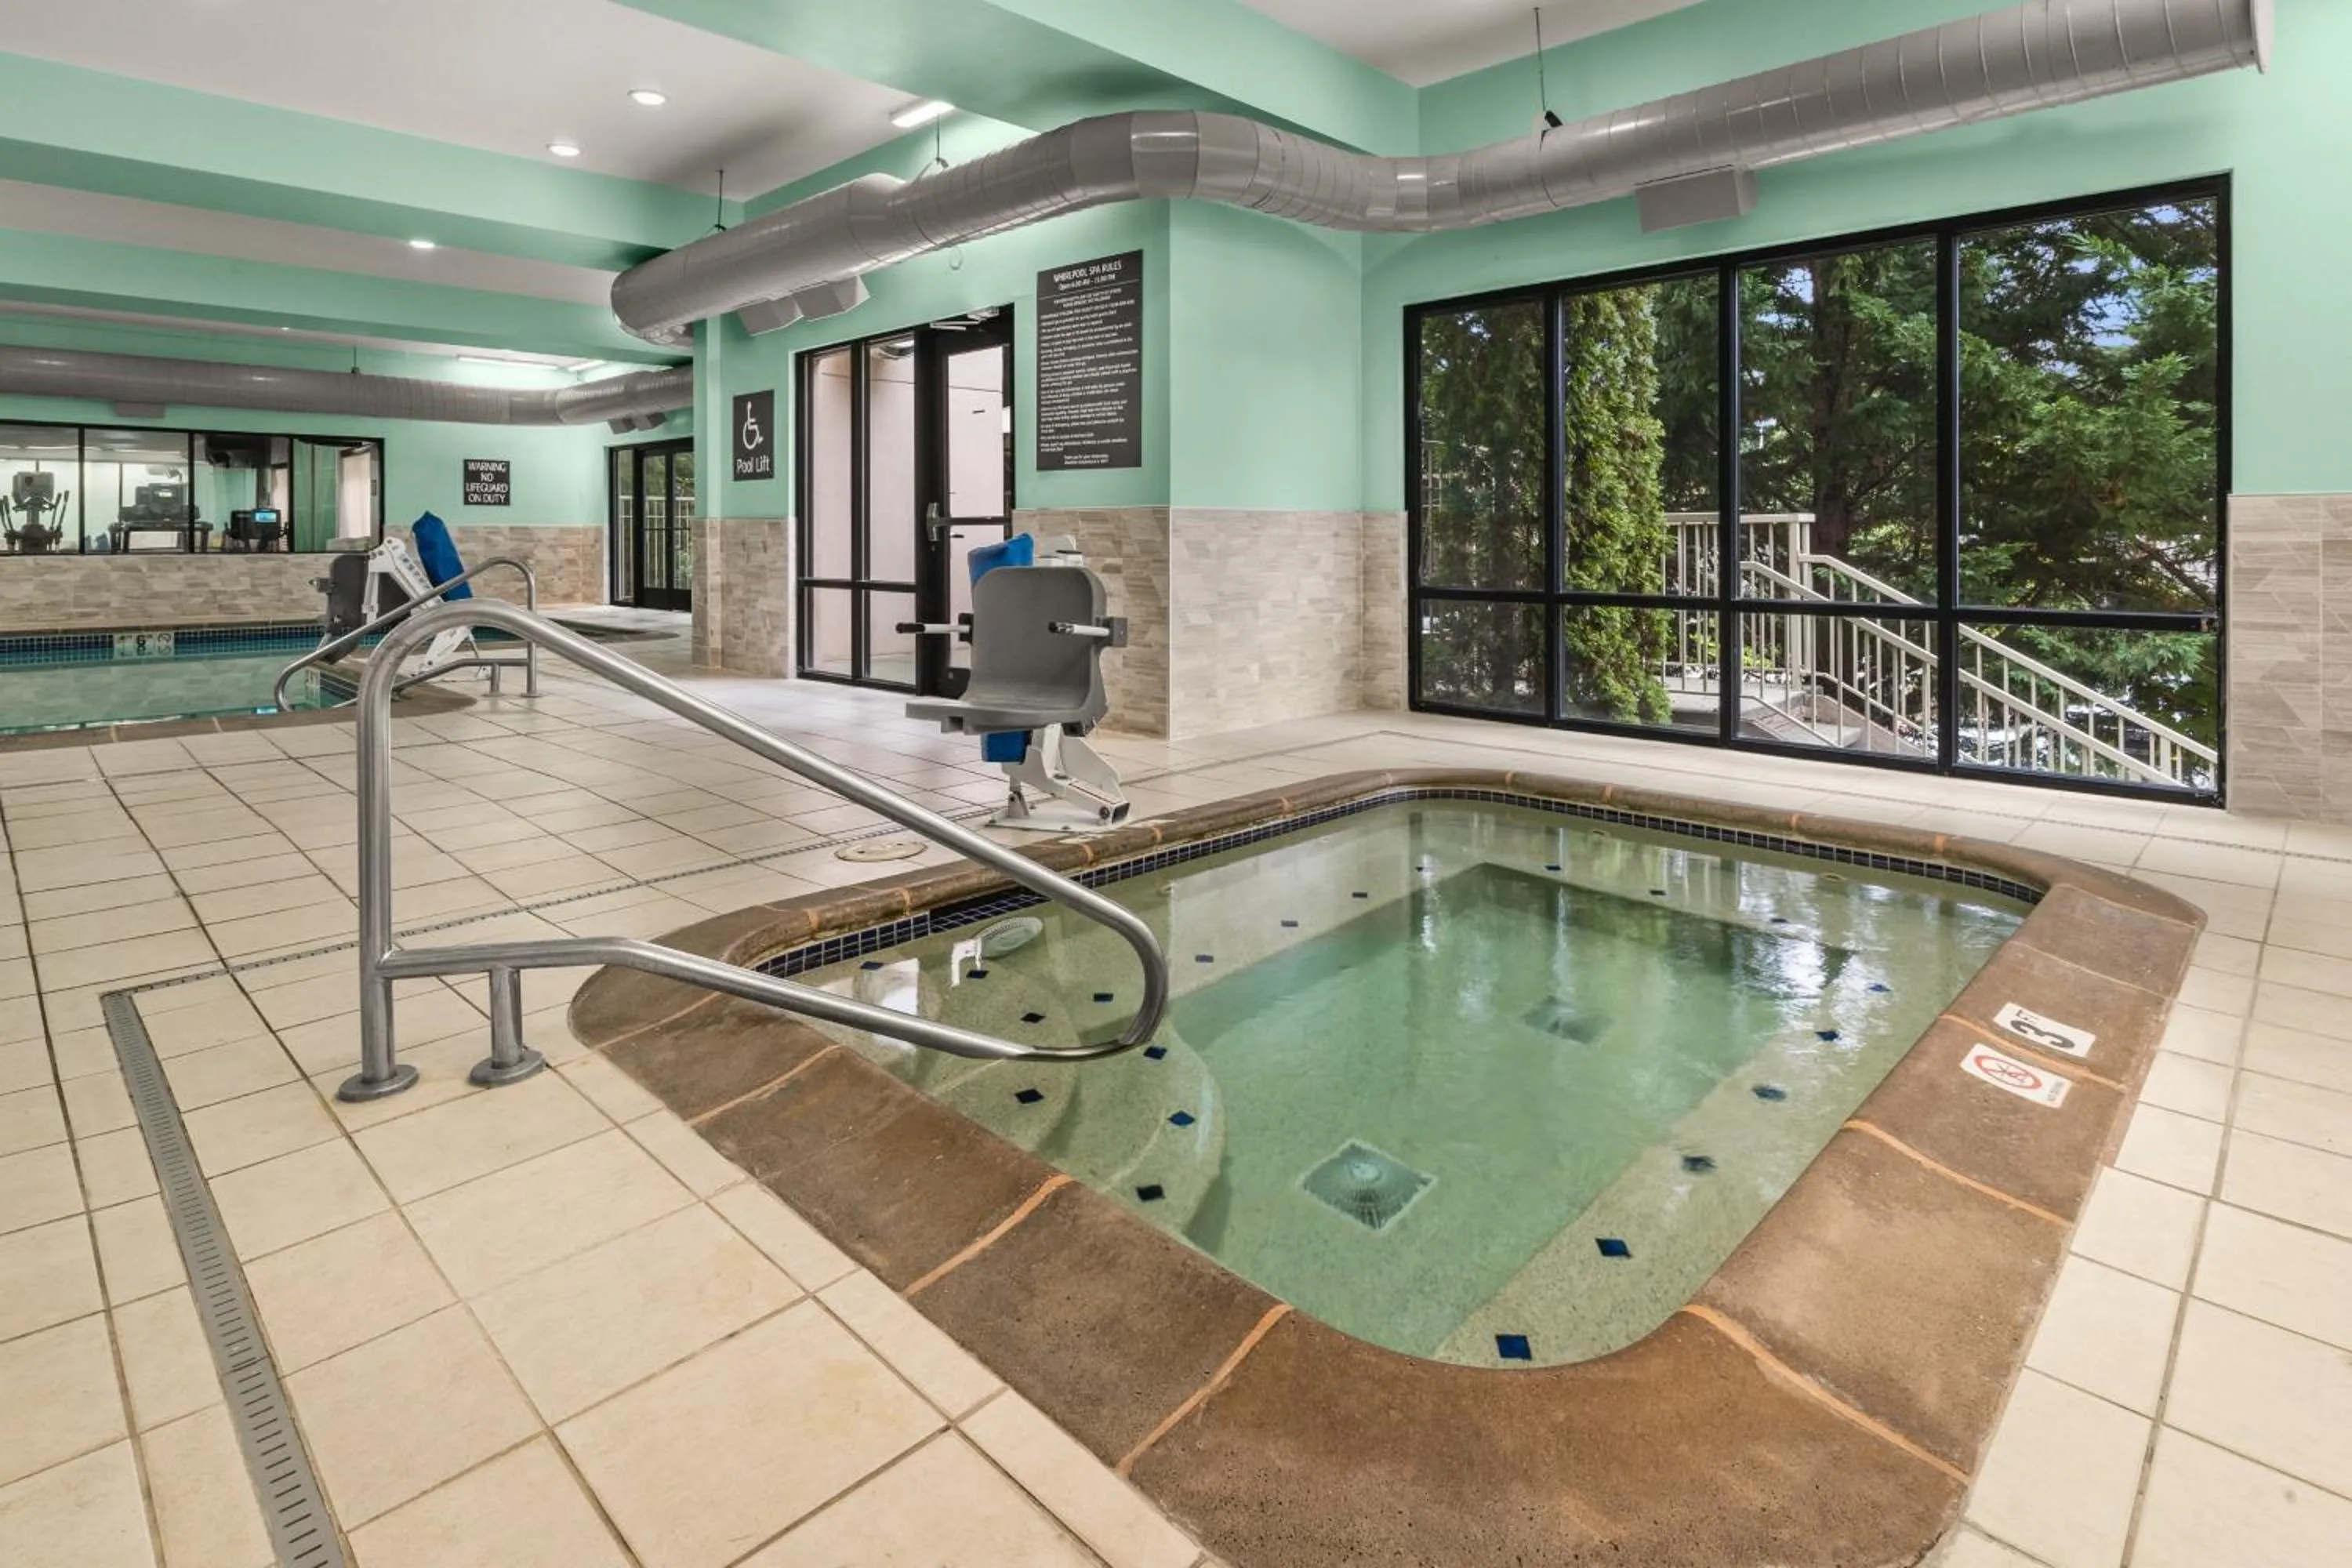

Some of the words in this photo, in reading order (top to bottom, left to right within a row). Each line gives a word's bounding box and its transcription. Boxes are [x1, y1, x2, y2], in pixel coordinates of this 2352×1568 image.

[1053, 267, 1088, 282] WHIRLPOOL
[1089, 264, 1101, 275] SPA
[1102, 260, 1122, 273] RULES
[468, 462, 506, 472] WARNING
[736, 456, 754, 474] Pool
[755, 455, 771, 473] Lift
[481, 472, 494, 482] NO
[466, 482, 509, 493] LIFEGUARD
[468, 493, 482, 503] ON
[483, 493, 506, 503] DUTY
[2010, 1020, 2075, 1049] 3
